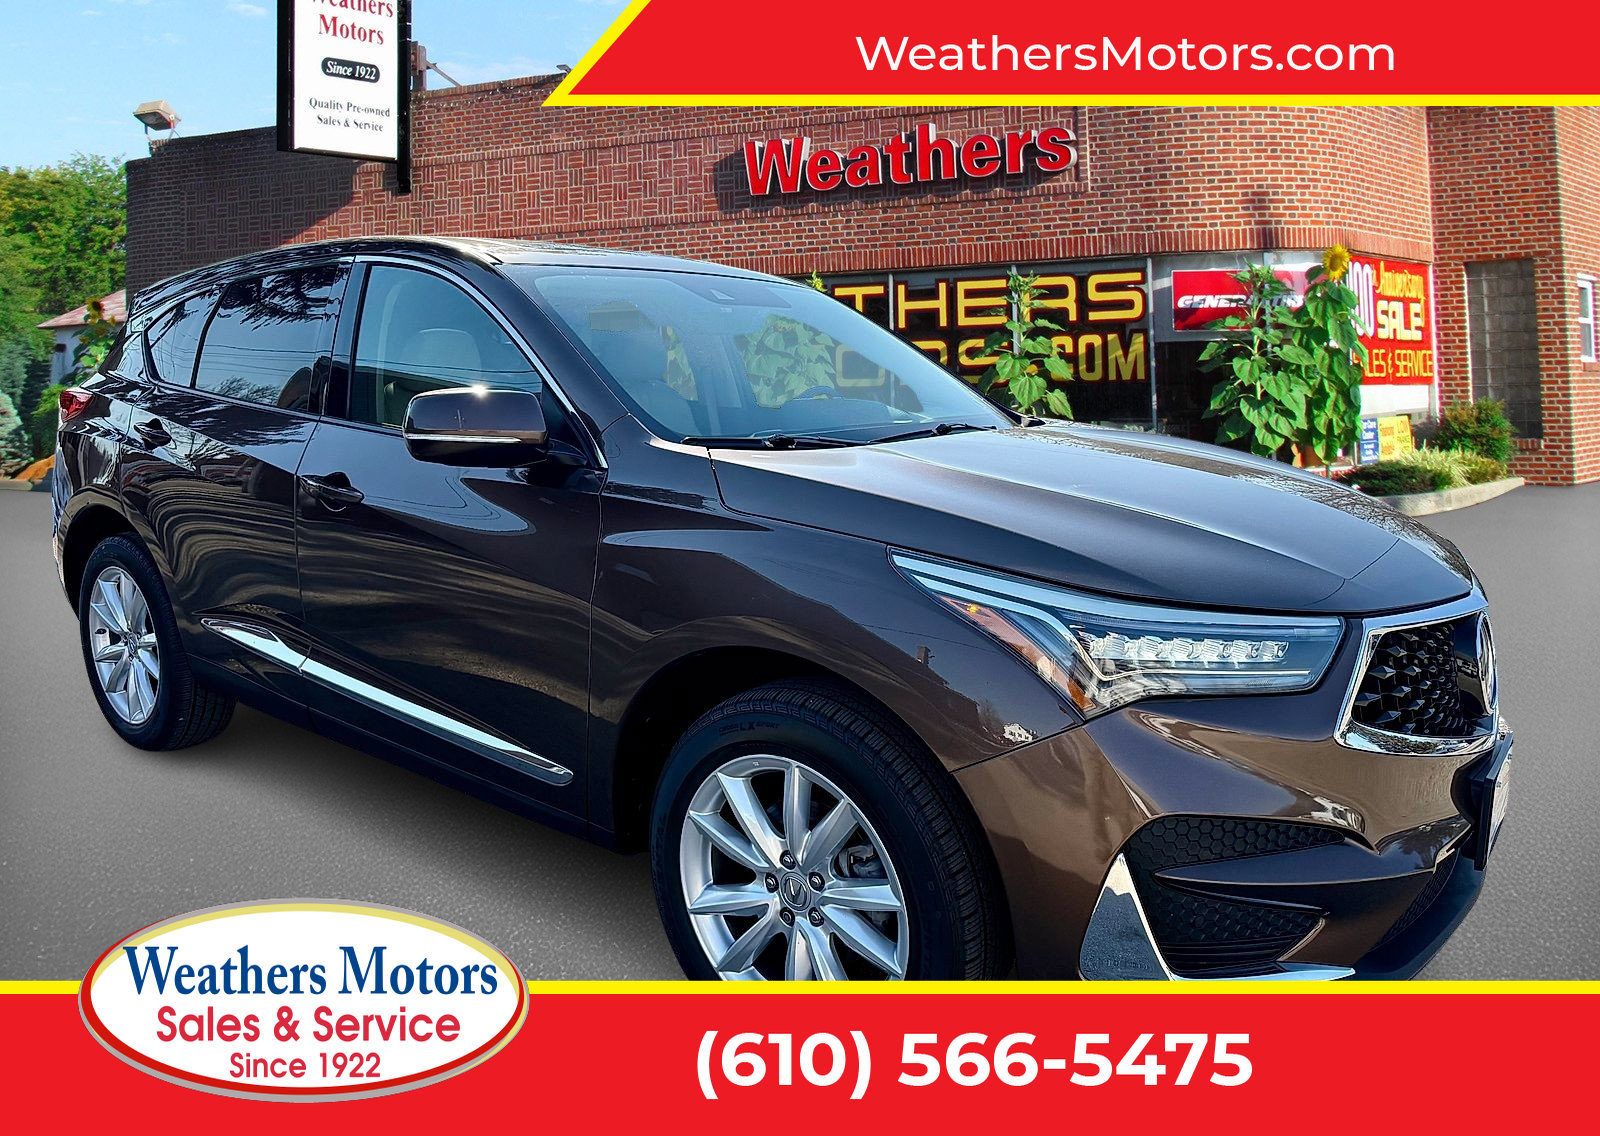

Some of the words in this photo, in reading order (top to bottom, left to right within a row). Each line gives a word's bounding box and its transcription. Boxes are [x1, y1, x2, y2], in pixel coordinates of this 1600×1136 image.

[313, 0, 393, 18] athers
[319, 13, 384, 46] Motors
[326, 60, 353, 76] Since
[355, 65, 376, 80] 1922
[309, 97, 344, 112] Quality
[346, 101, 391, 118] Pre-owned
[316, 114, 341, 127] Sales
[343, 118, 351, 128] &
[353, 119, 384, 132] Service
[743, 122, 1078, 196] Weathers
[1377, 299, 1423, 340] SALE
[1353, 349, 1387, 377] LES
[1395, 349, 1434, 377] SERVICE
